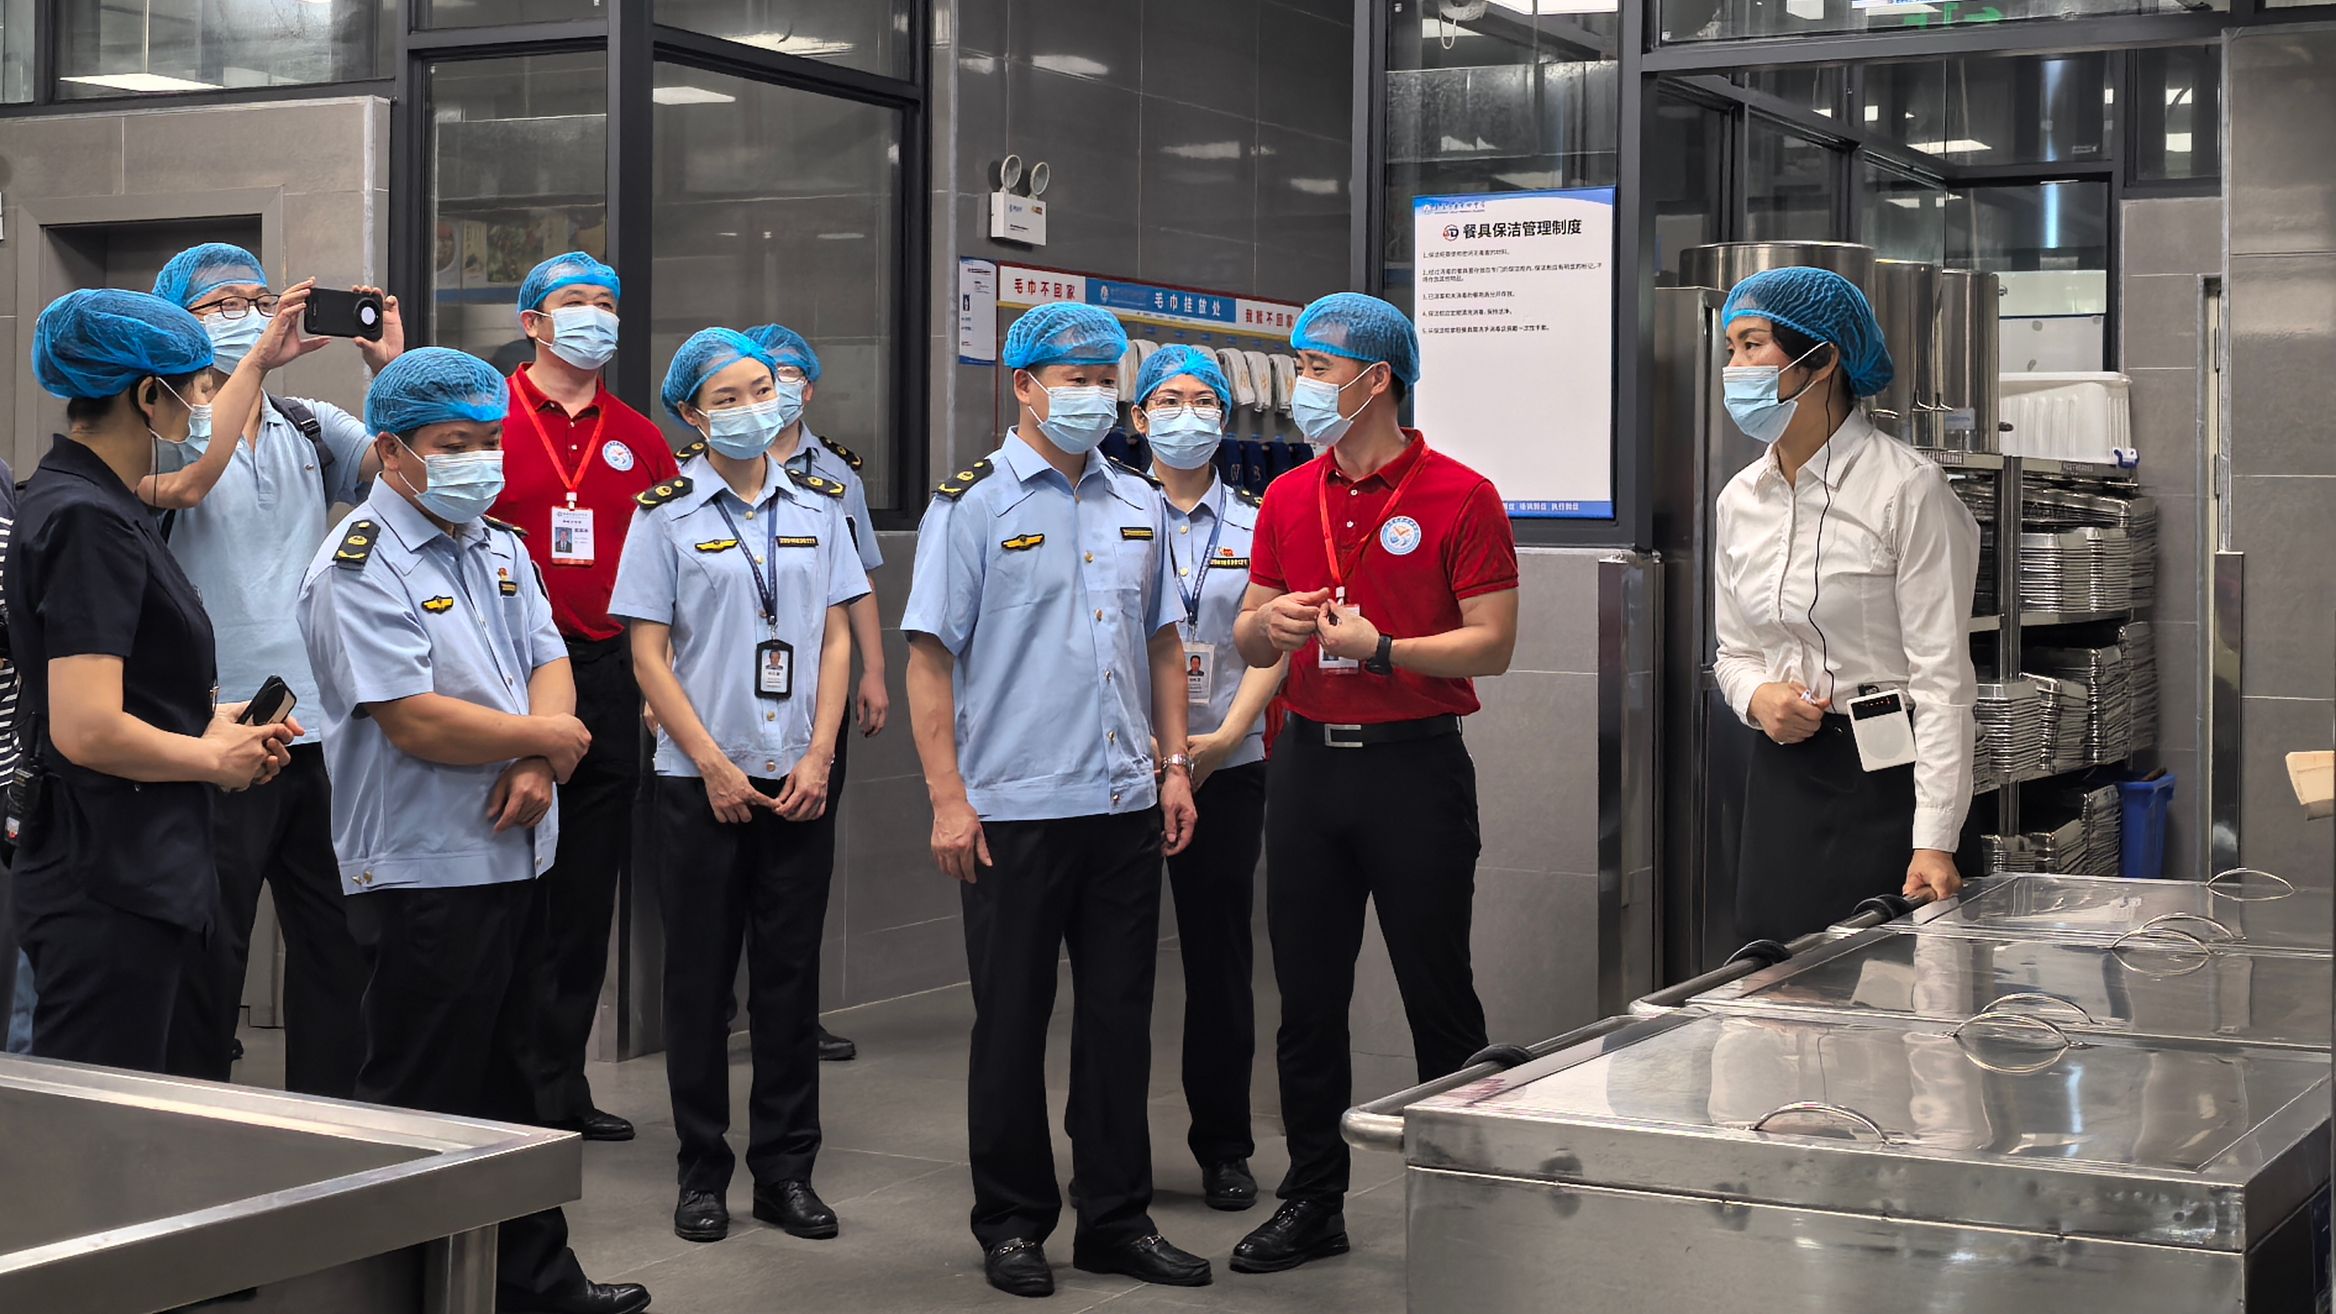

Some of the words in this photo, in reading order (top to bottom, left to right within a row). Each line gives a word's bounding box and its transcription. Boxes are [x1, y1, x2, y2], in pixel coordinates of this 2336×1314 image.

[1463, 219, 1582, 239] 餐具保洁管理制度
[1015, 278, 1075, 299] 毛巾不回家
[1154, 292, 1220, 316] 毛巾挂放处
